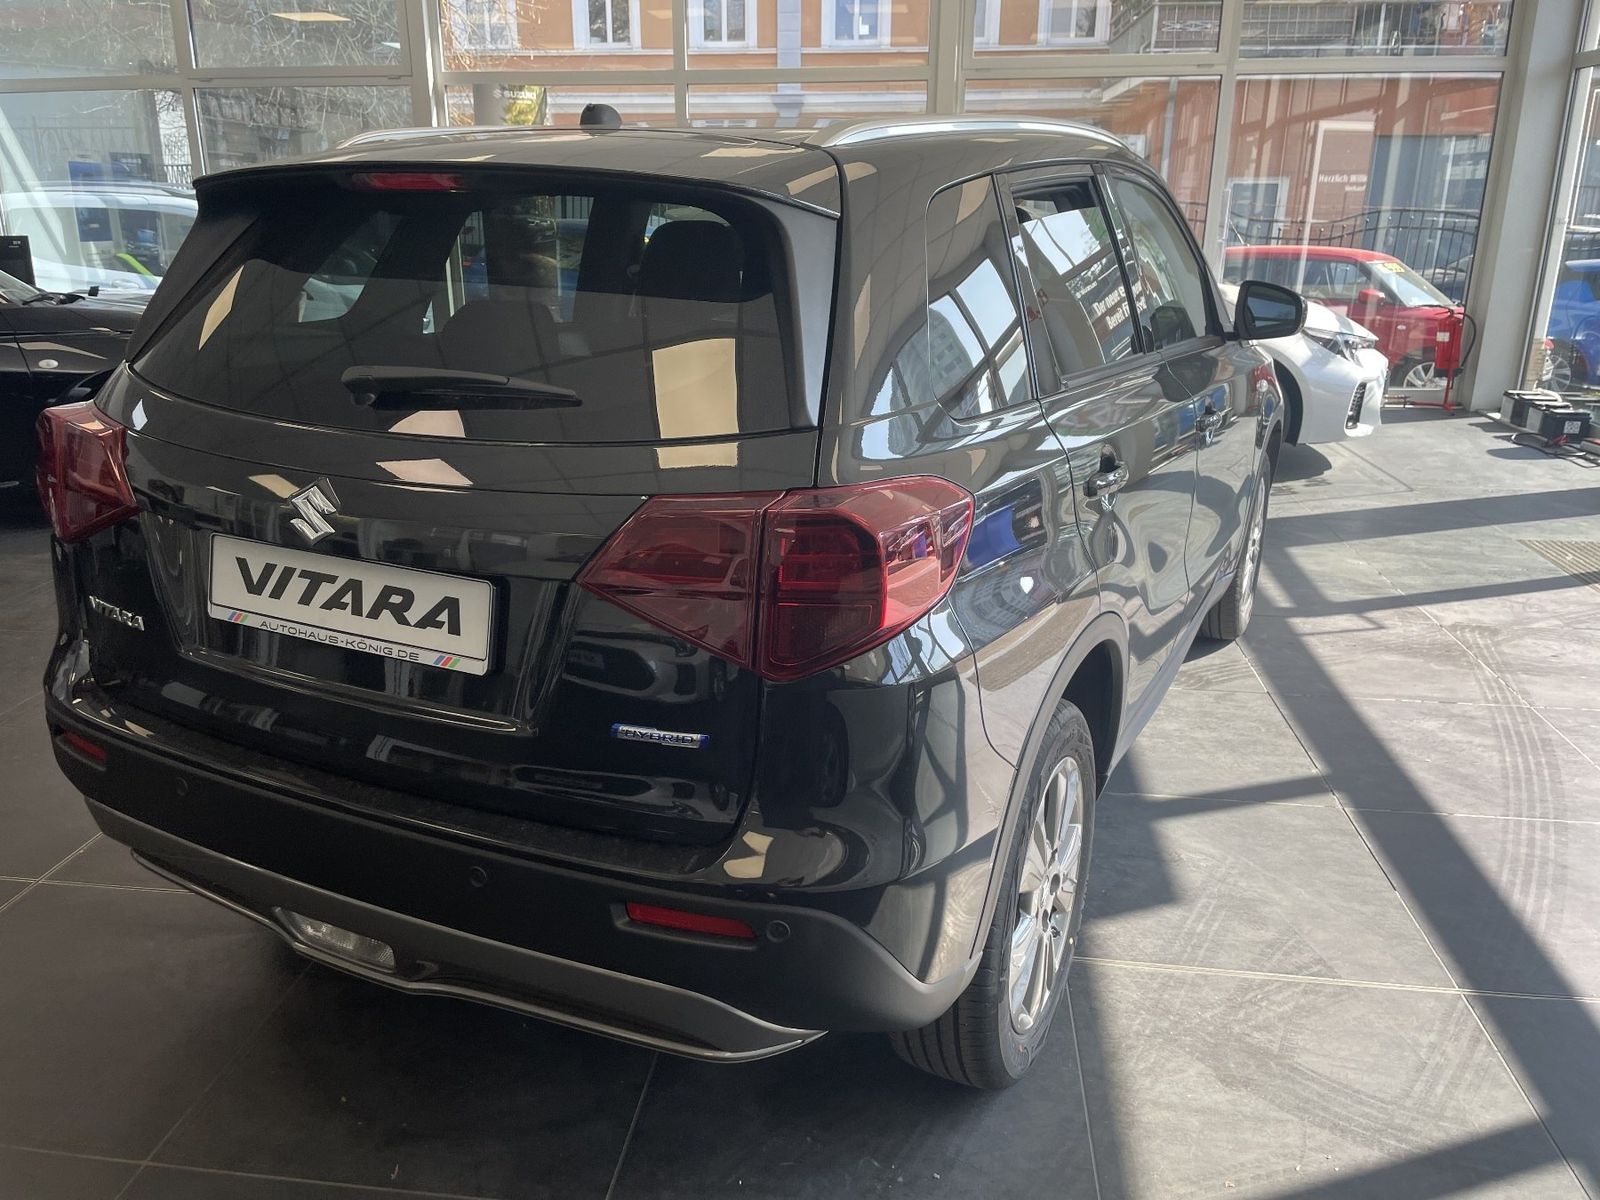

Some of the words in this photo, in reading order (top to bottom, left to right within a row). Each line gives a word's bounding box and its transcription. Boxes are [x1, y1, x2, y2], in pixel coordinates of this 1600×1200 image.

[503, 90, 537, 99] SUZUKI
[1092, 300, 1108, 316] Der
[1105, 307, 1126, 330] Bereit
[235, 556, 461, 637] VITARA
[89, 595, 145, 631] VITARA
[624, 729, 695, 744] HYBRID
